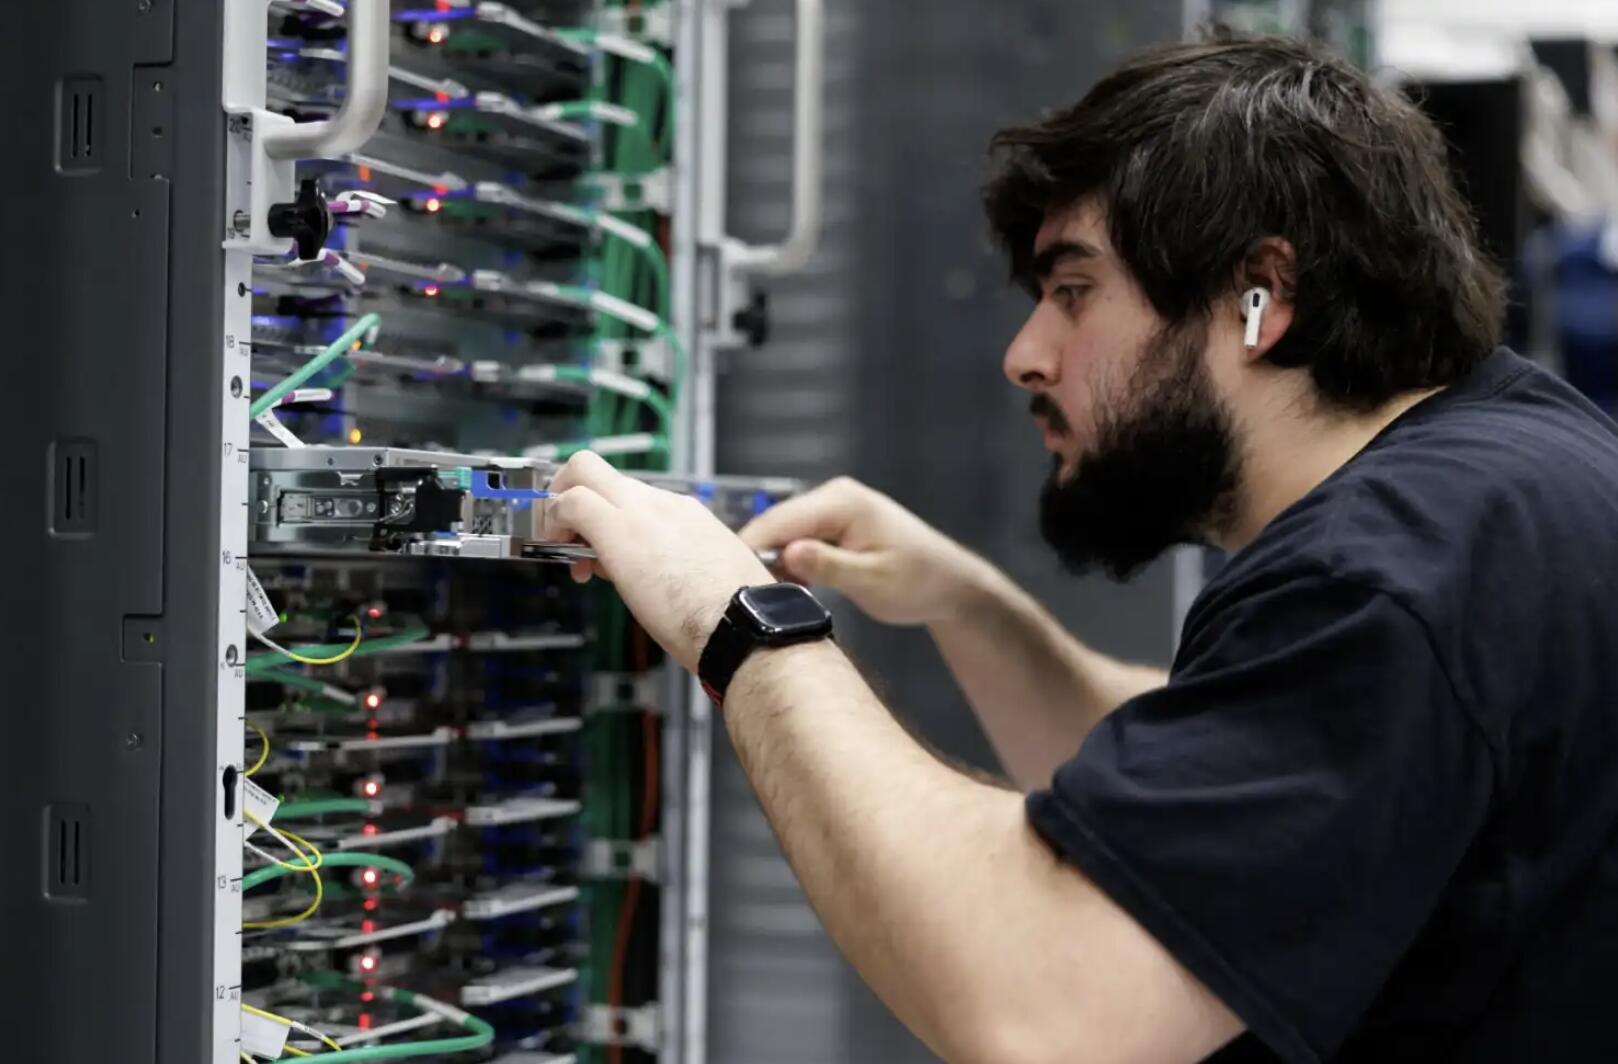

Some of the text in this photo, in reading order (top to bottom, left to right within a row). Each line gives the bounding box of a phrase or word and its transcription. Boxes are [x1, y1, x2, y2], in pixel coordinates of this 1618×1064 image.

[226, 334, 235, 349] 18
[223, 442, 233, 456] 17
[222, 550, 231, 565] 16
[217, 875, 227, 889] 13
[216, 985, 225, 1000] 12
